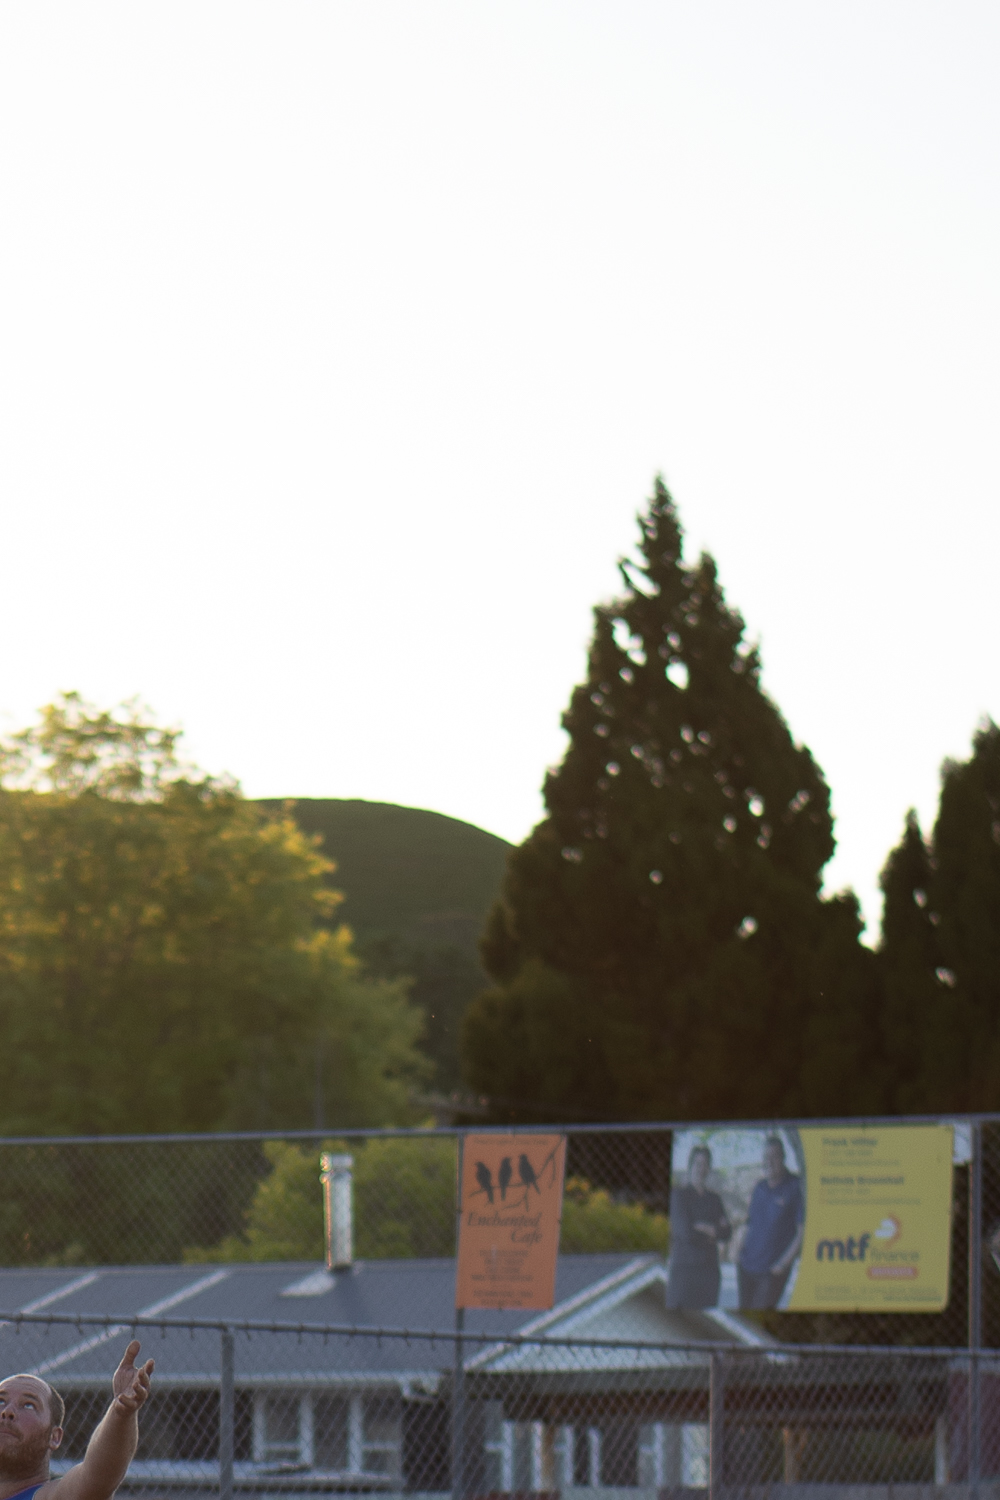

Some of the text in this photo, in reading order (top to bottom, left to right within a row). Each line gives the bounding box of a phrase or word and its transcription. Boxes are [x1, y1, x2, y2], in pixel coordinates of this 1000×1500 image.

[467, 1211, 542, 1228] Enchanted
[510, 1230, 543, 1247] Cafe
[816, 1233, 920, 1262] mtf finance
